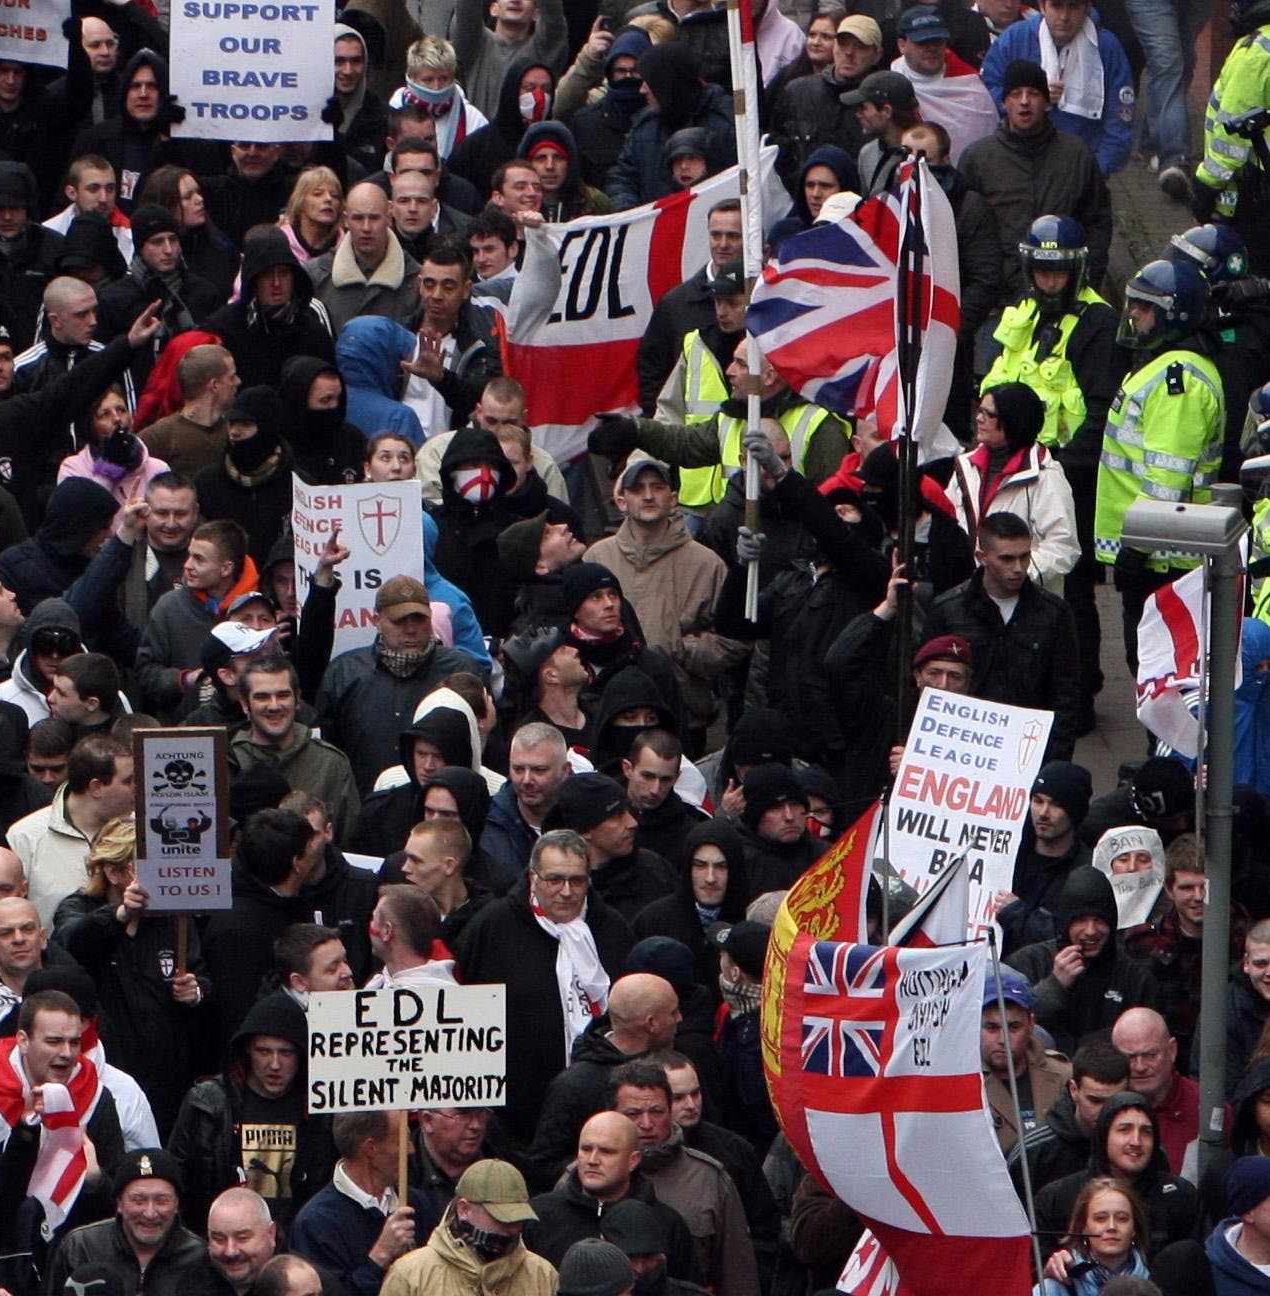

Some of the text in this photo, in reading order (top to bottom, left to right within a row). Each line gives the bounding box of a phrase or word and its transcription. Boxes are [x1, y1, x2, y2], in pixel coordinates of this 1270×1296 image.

[183, 1, 319, 22] SUPPORT
[219, 37, 282, 55] OUR
[202, 70, 298, 88] BRAVE
[192, 102, 309, 121] TROOPS
[354, 568, 382, 590] IS
[926, 694, 1009, 727] ENGLISH
[920, 716, 1004, 749] DEFENCE
[155, 751, 205, 760] ACHTUNG
[913, 738, 998, 772] LEAGUE
[898, 764, 1030, 822] ENGLAND
[896, 807, 1013, 855] WILL NEVER
[162, 844, 202, 855] unite
[1110, 833, 1145, 853] BAN
[158, 866, 215, 878] LISTEN
[969, 859, 984, 885] A
[159, 885, 181, 896] TO
[187, 885, 211, 896] US
[355, 989, 464, 1028] EDL
[311, 1026, 504, 1058] REPRESENTING
[386, 1057, 423, 1073] THE
[311, 1075, 507, 1110] SILENT MAJORITY
[245, 1128, 293, 1146] PUMA
